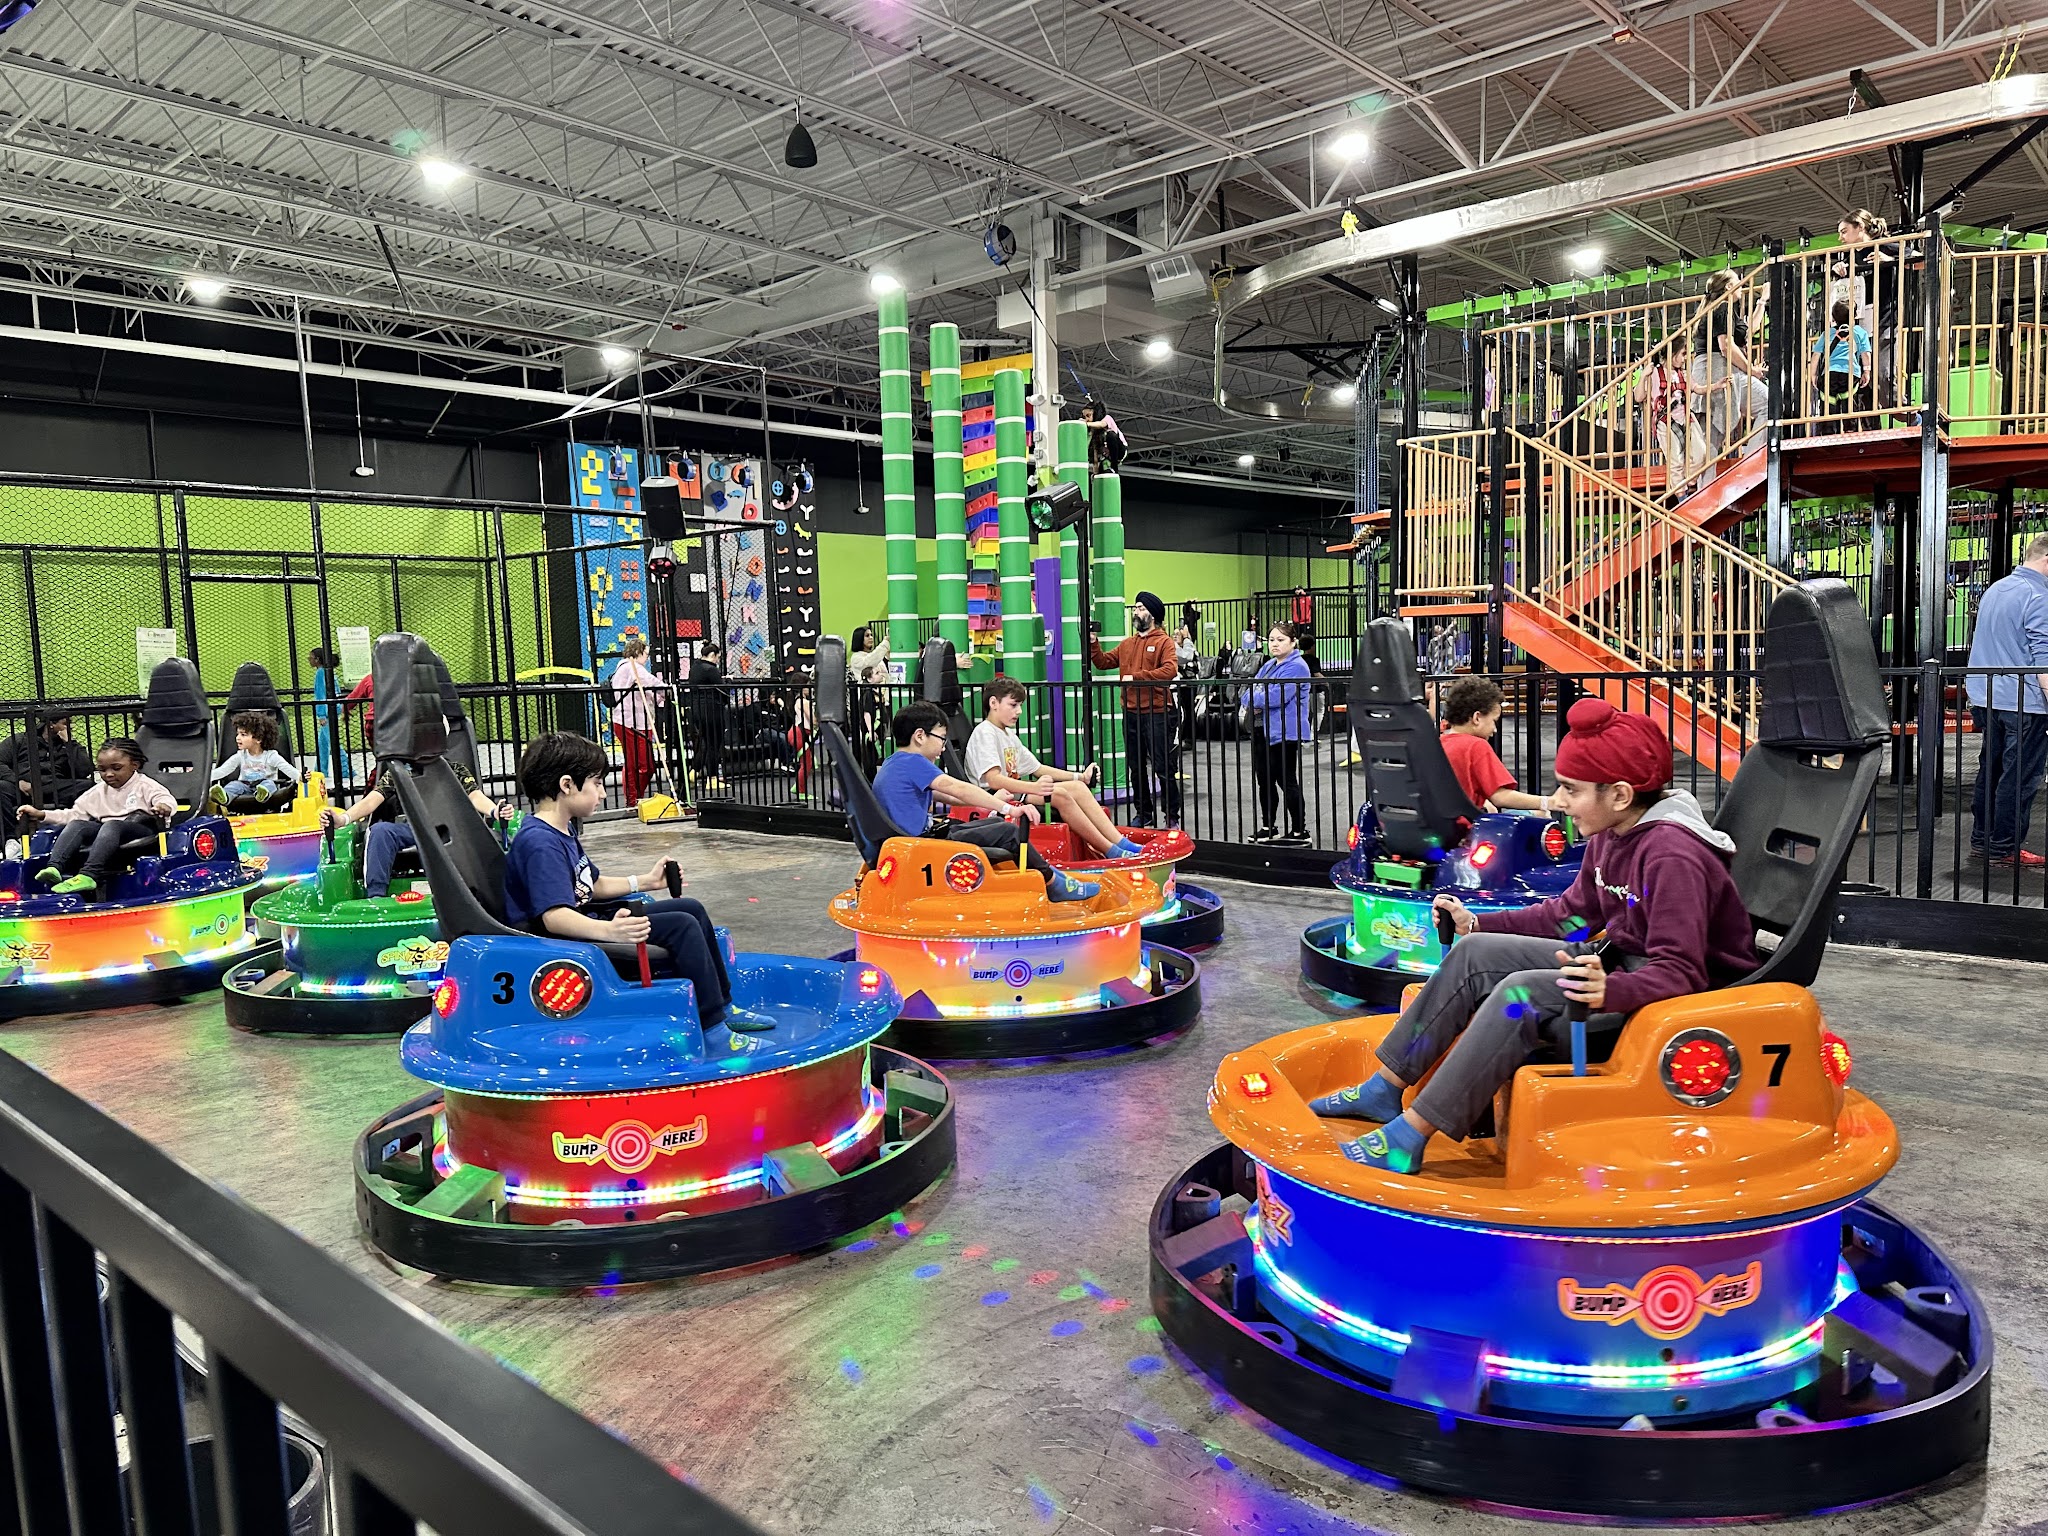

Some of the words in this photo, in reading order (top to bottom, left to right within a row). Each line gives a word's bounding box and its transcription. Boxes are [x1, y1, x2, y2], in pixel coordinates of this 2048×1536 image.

[921, 863, 933, 887] 1
[973, 971, 999, 979] BUMP
[1039, 965, 1060, 975] HERE
[492, 971, 515, 1005] 3
[1761, 1043, 1791, 1087] 7
[563, 1143, 598, 1156] BUMP
[662, 1129, 696, 1147] HERE
[1575, 1296, 1627, 1311] BUMP
[1711, 1281, 1748, 1304] HERE
